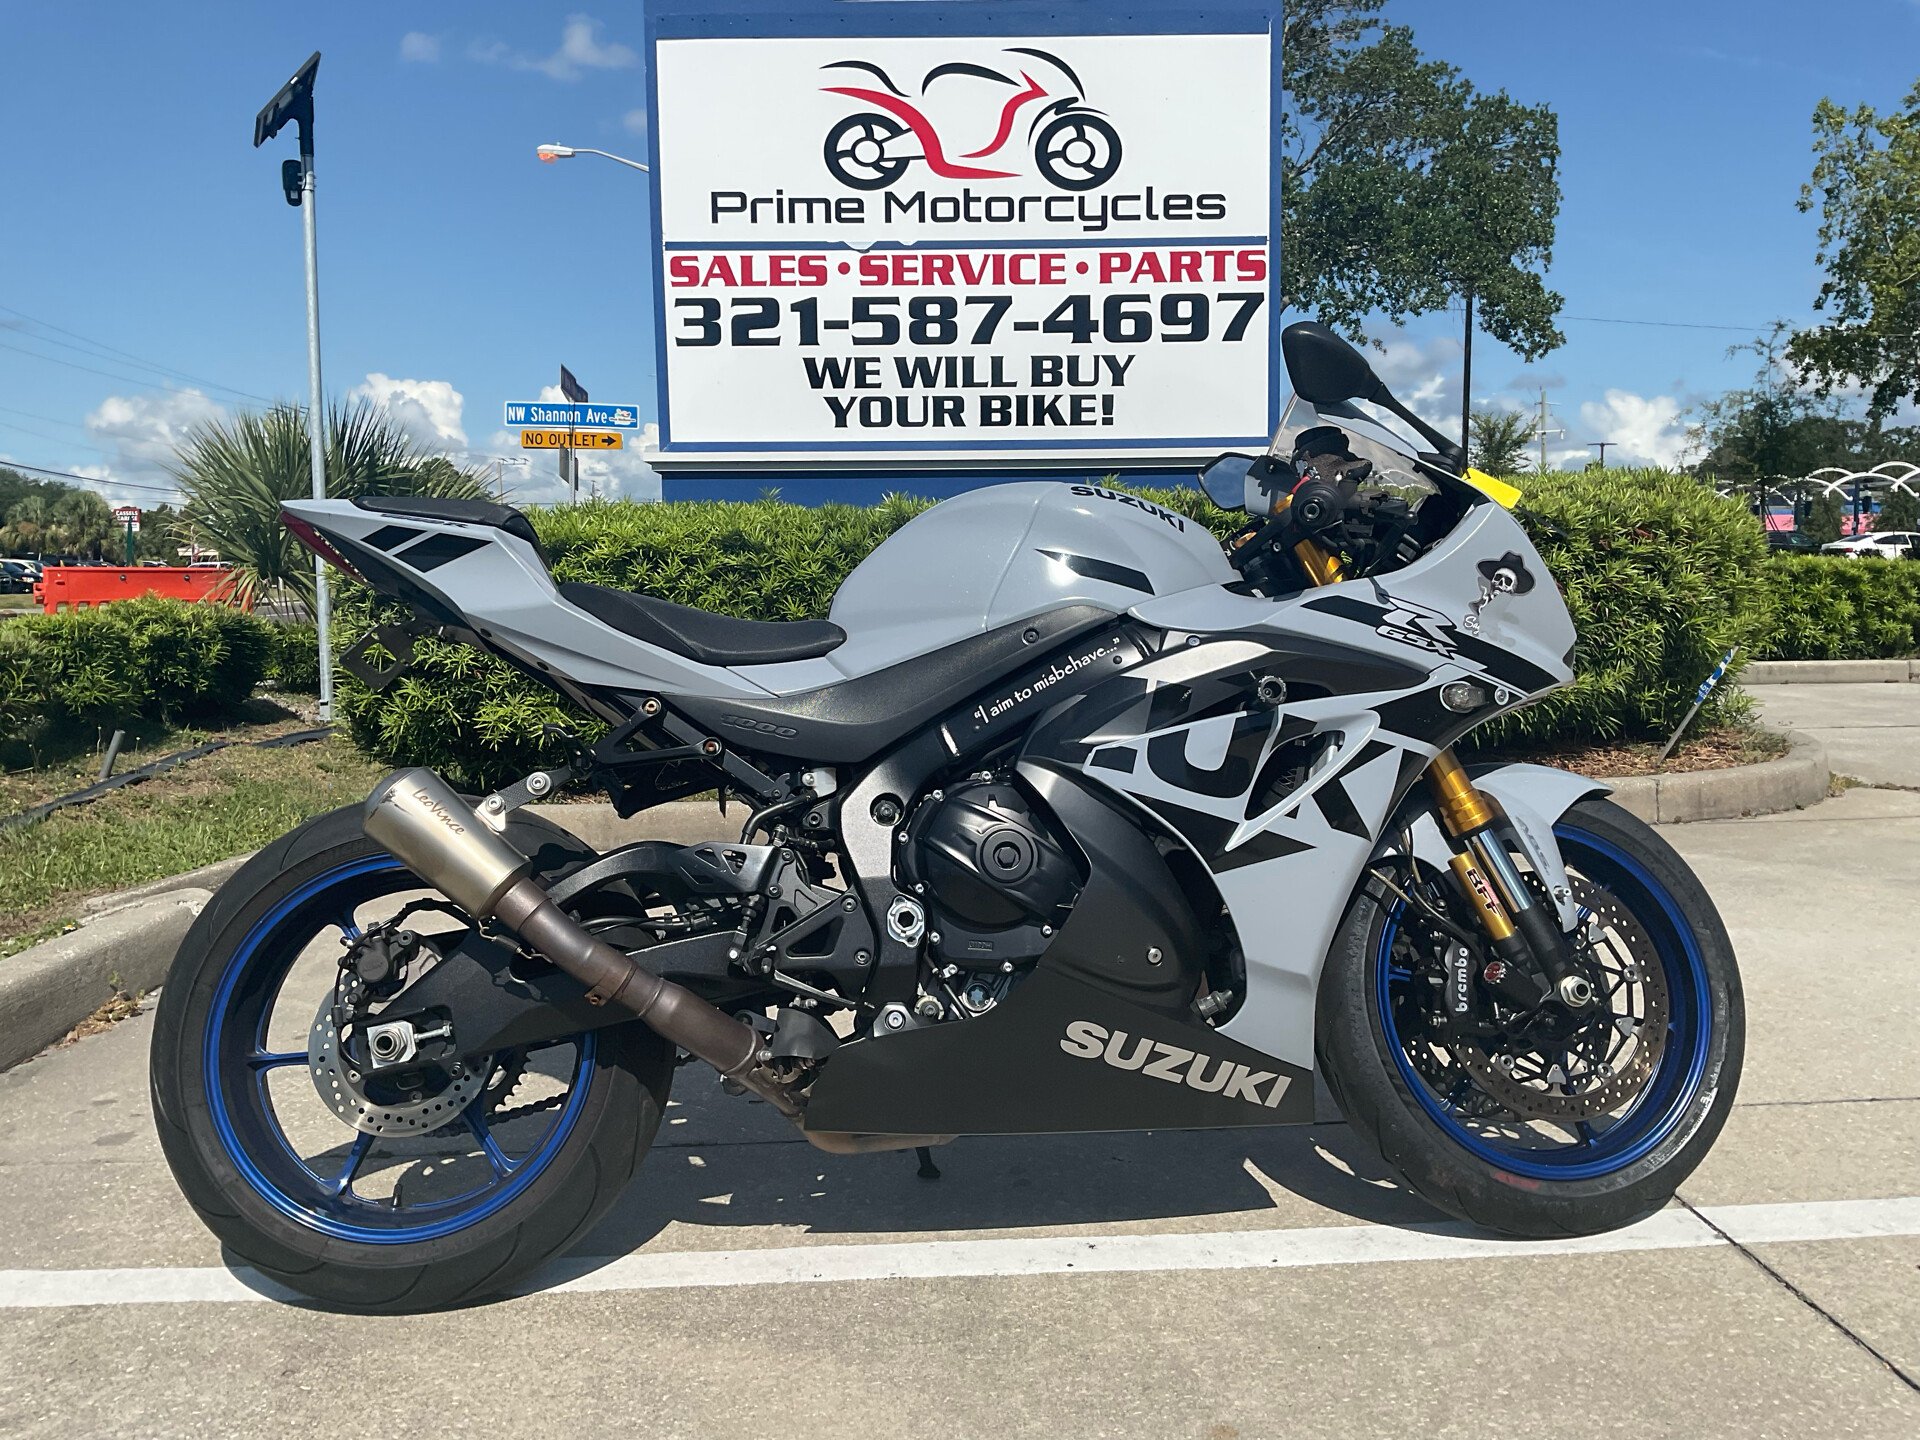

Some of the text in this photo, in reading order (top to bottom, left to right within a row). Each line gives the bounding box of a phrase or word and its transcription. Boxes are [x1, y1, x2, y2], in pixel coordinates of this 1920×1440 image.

[711, 187, 1227, 231] Prime Motorcycles
[670, 250, 1266, 286] SALES SERVICE PARTS
[675, 293, 1264, 346] 321-587-4697
[803, 355, 1135, 389] WE WILL BUY
[508, 406, 608, 424] NW Shannon Ave
[823, 394, 1113, 427] YOUR BIKE!
[525, 433, 598, 447] NO OUTLET
[1070, 486, 1185, 534] SUZUKI
[990, 700, 1014, 717] aim
[1014, 688, 1032, 702] to
[1454, 947, 1469, 1013] brembo
[1060, 1020, 1292, 1108] SUZUKI
